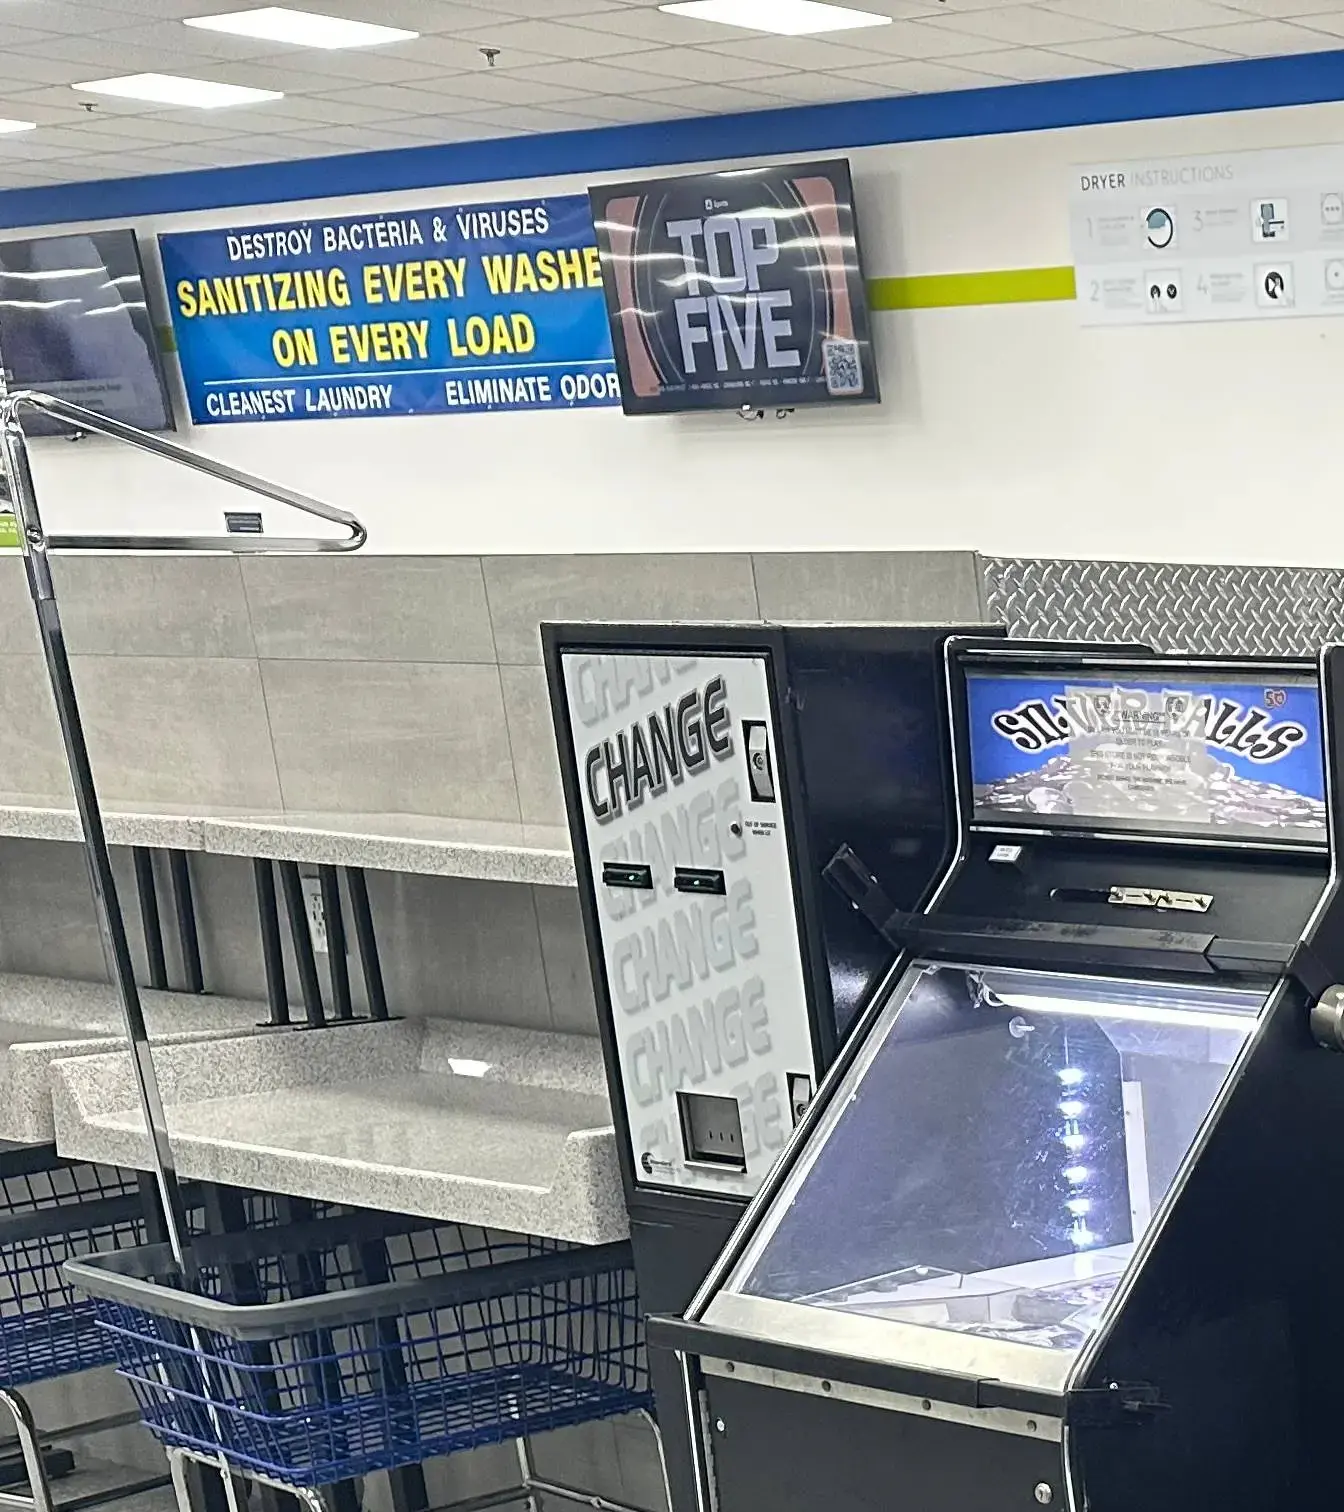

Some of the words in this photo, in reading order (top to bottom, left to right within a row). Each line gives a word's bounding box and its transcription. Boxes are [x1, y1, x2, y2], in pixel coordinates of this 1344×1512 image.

[1080, 173, 1126, 192] DRYER
[1129, 164, 1234, 188] INSTRUCTIONS
[227, 226, 312, 262] DESTROY
[323, 217, 423, 253] BACTERIA
[432, 216, 447, 243] &
[456, 207, 549, 241] VIRUSES
[666, 217, 779, 296] TOP
[176, 268, 347, 319] SANITIZING
[363, 257, 466, 304] EVERY
[272, 327, 318, 368] ON
[330, 320, 428, 364] EVERY
[447, 312, 536, 357] LOAD
[674, 289, 801, 374] FIVE
[206, 388, 296, 417] CLEANEST
[304, 383, 393, 412] LAUNDRY
[446, 375, 551, 407] ELIMINATE
[583, 674, 734, 823] CHANGE
[612, 877, 760, 1015] CHANGE
[624, 975, 772, 1107] CHANGE
